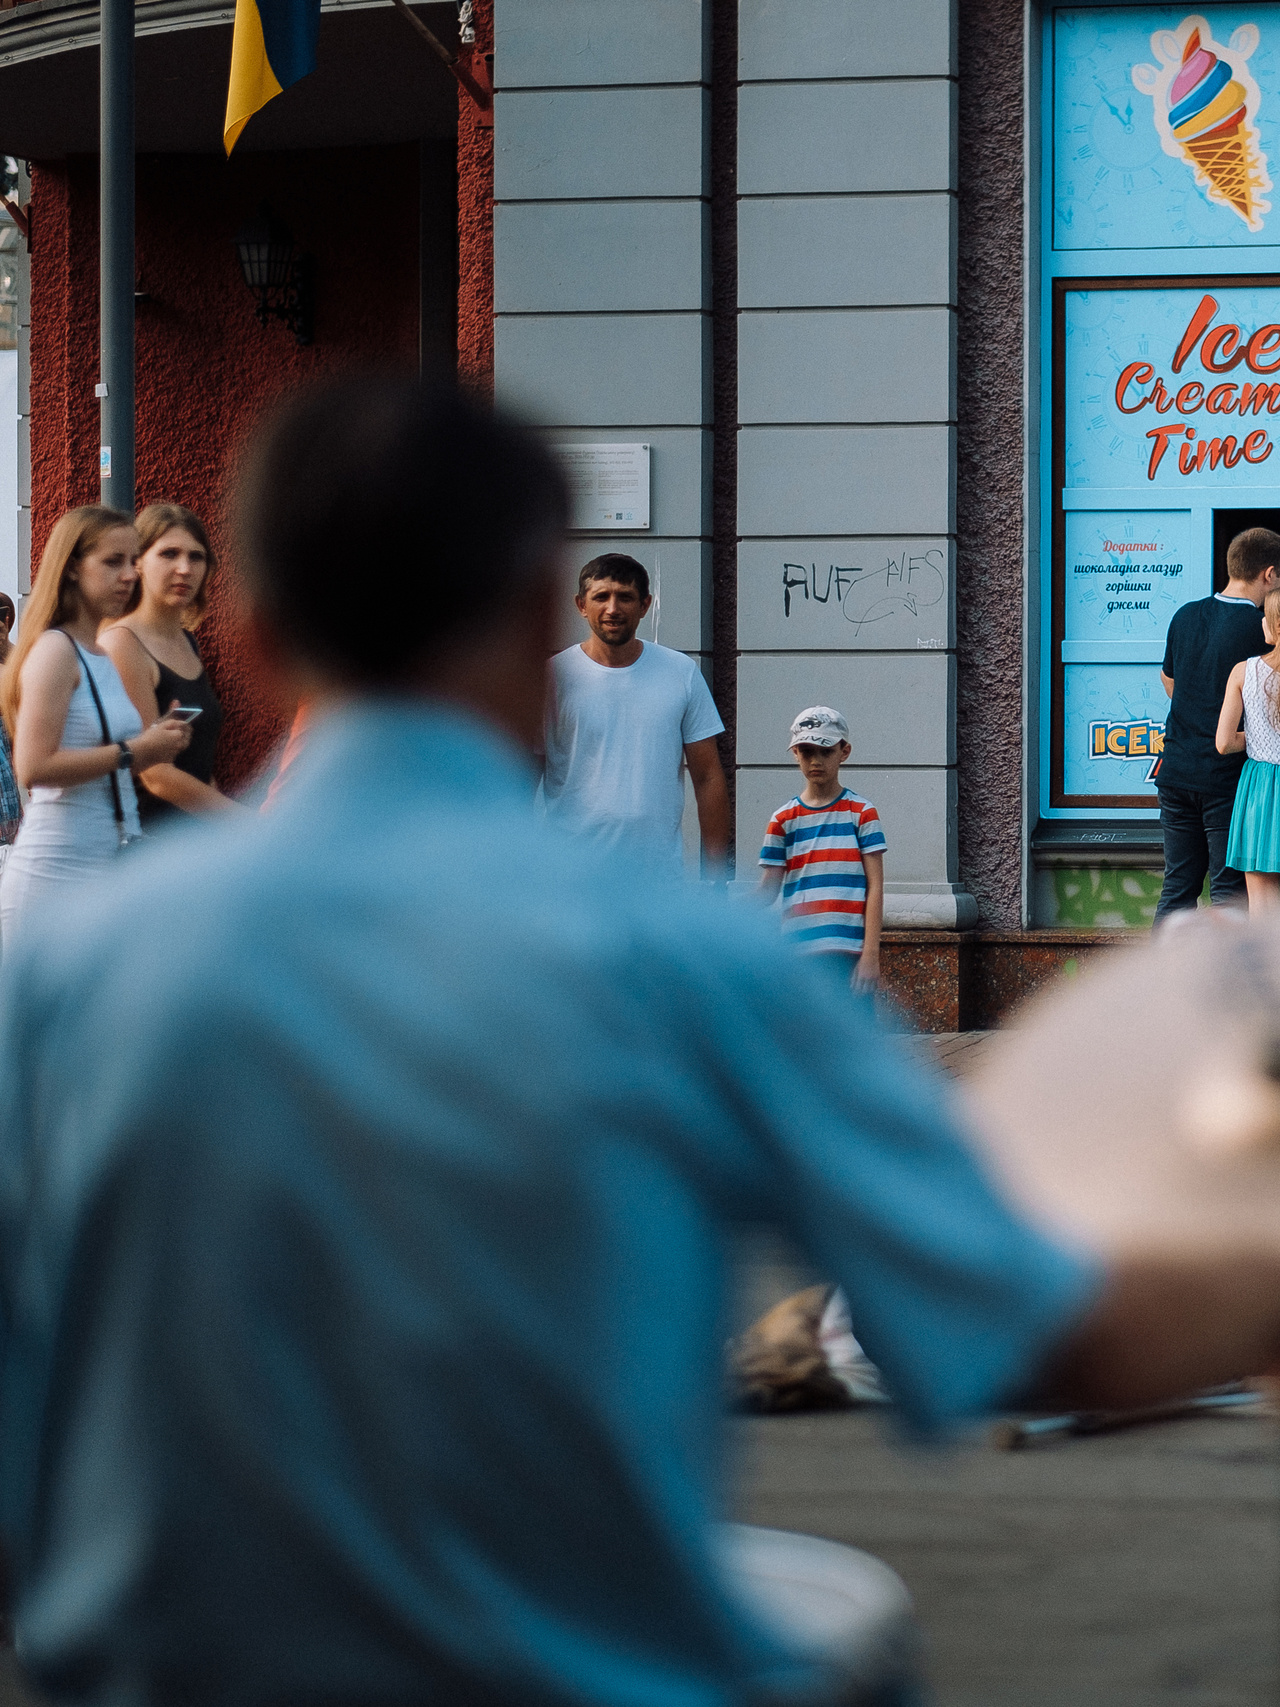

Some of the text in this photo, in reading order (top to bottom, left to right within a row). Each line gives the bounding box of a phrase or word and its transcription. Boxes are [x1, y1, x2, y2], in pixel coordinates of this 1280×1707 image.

[1145, 423, 1274, 481] Time
[1102, 540, 1158, 555] Додатки
[1073, 563, 1184, 577] шоколадна глазур
[1105, 580, 1151, 594] горішки
[1107, 601, 1150, 613] джеми
